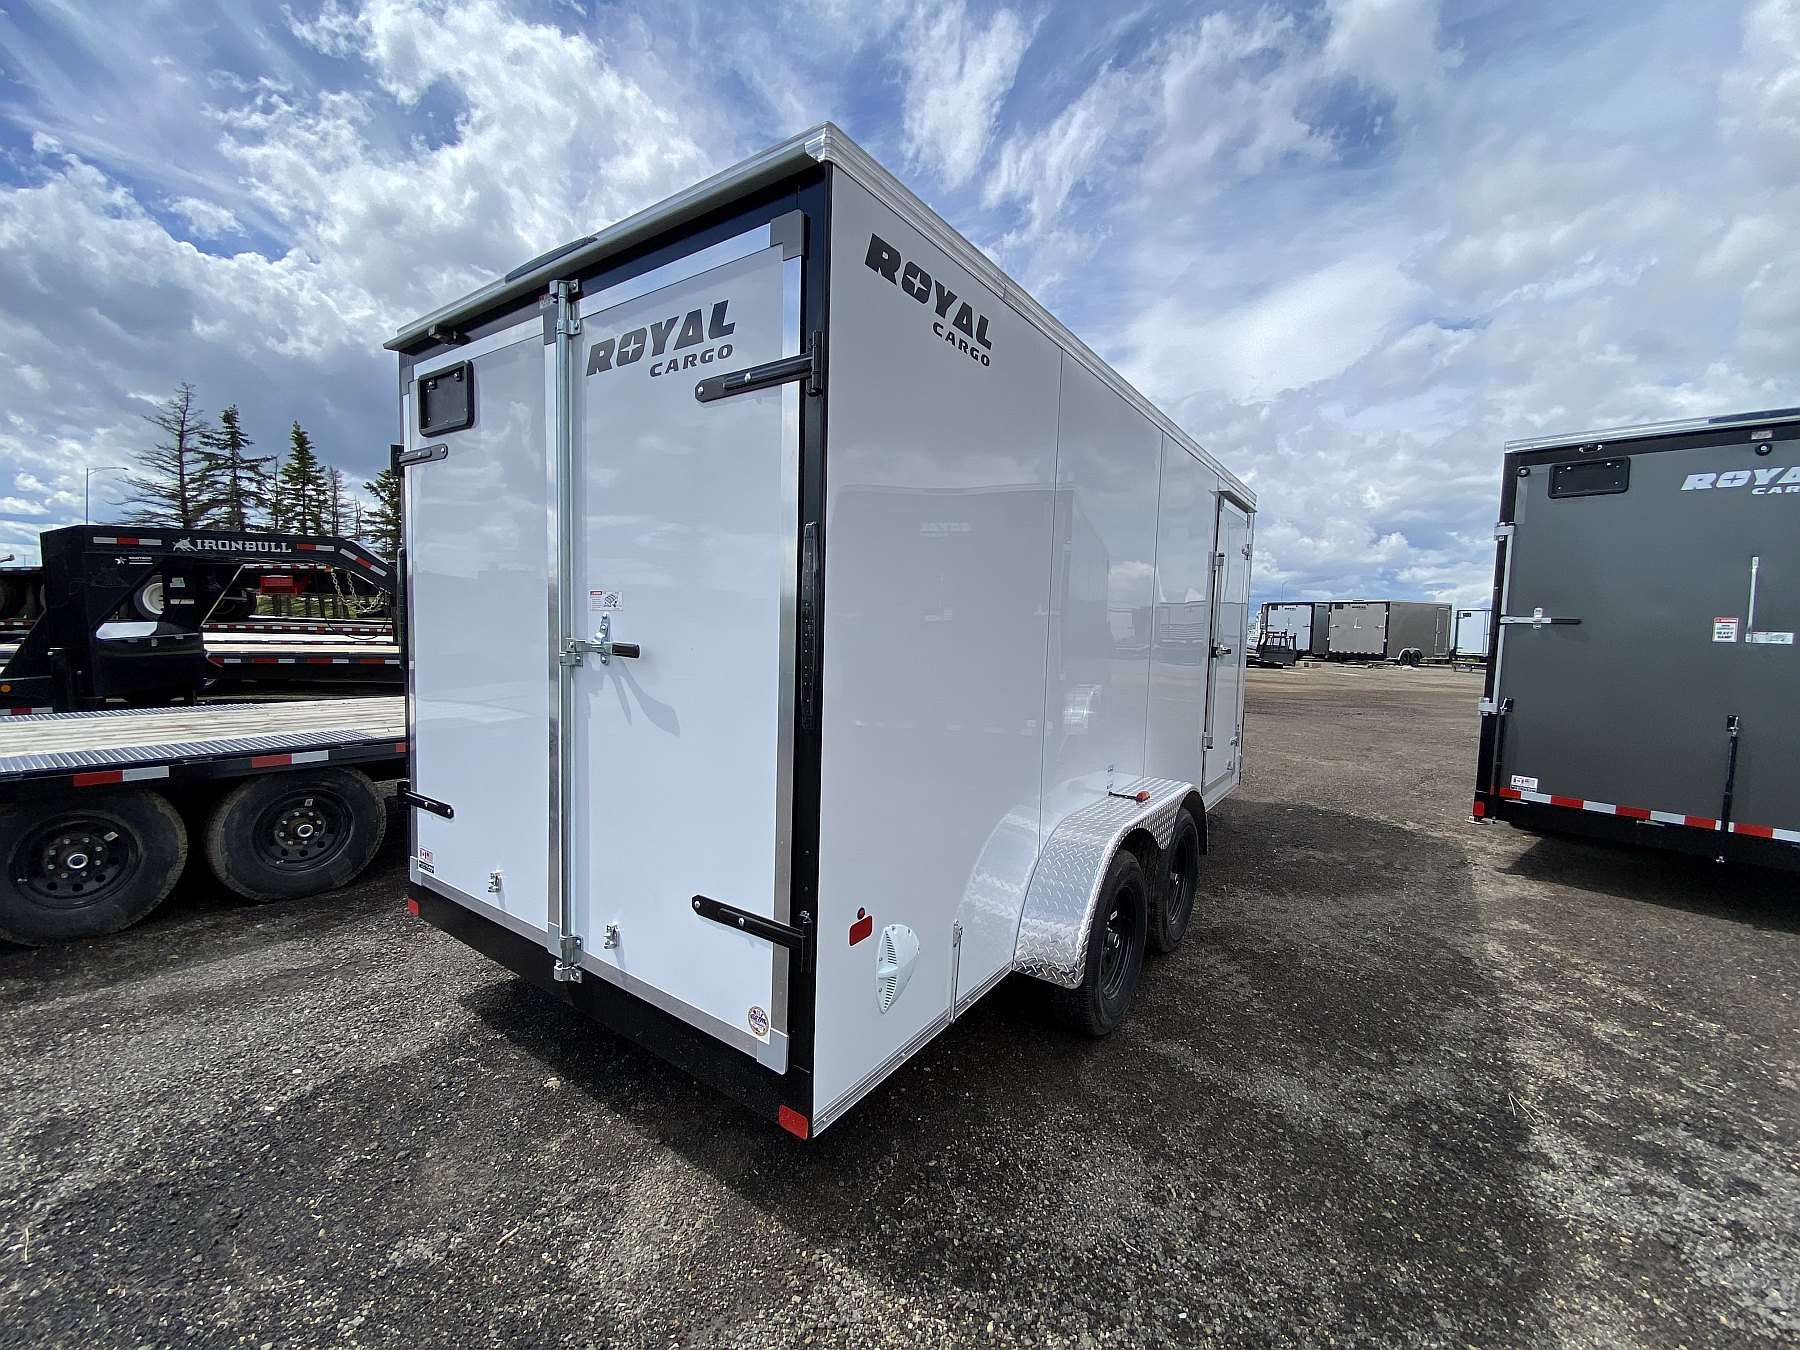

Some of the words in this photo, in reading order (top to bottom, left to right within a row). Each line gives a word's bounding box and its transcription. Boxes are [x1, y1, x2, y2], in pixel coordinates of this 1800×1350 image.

[865, 233, 992, 350] ROYAL
[586, 300, 735, 376] ROYAL
[933, 322, 990, 366] CARGO
[650, 344, 733, 377] CARGO
[196, 540, 292, 552] IRONBULL
